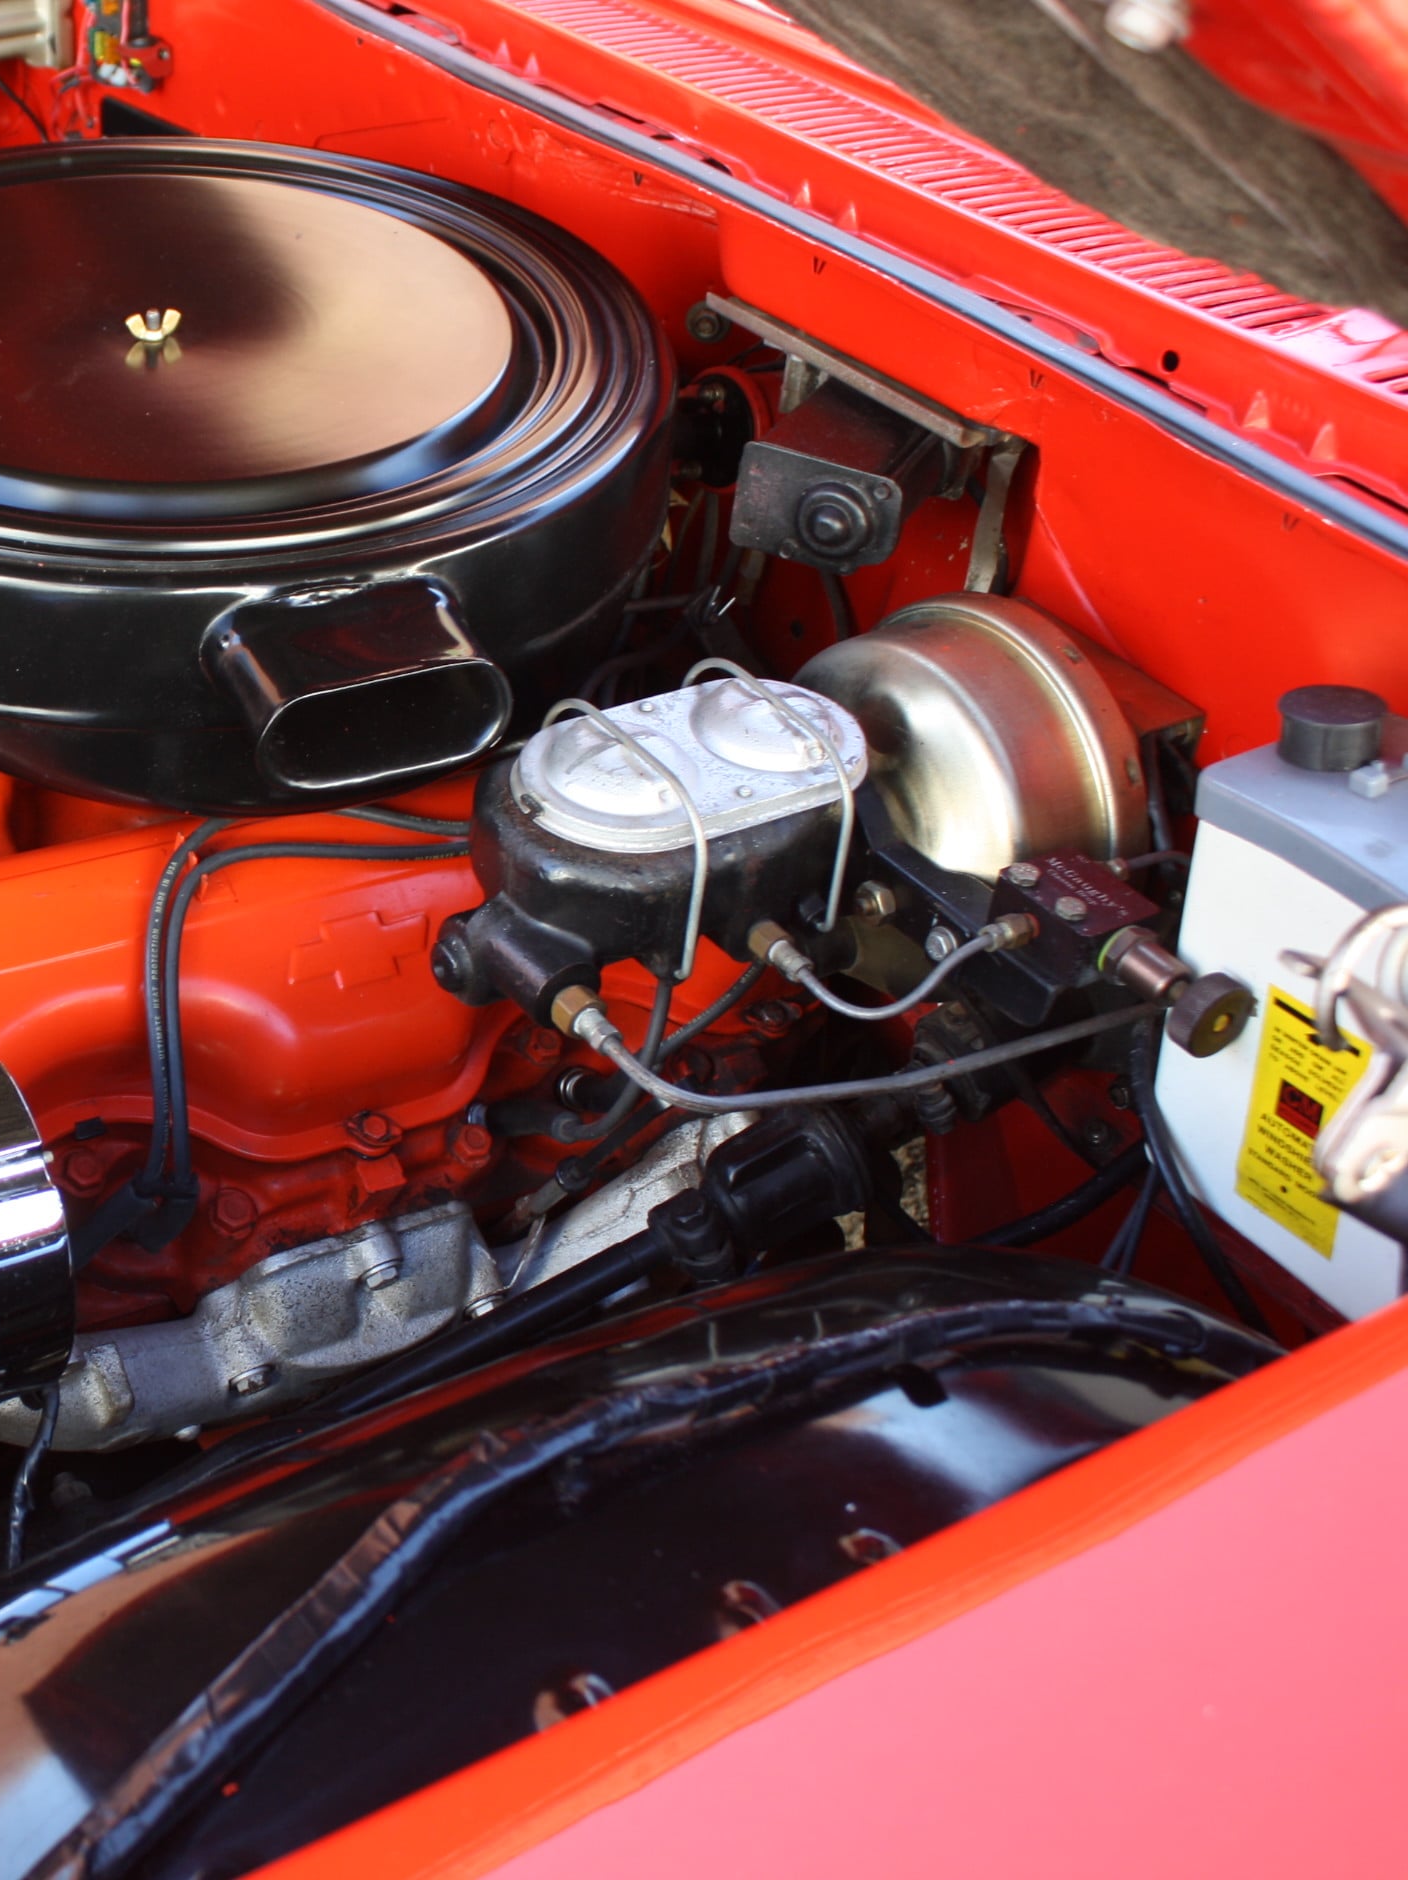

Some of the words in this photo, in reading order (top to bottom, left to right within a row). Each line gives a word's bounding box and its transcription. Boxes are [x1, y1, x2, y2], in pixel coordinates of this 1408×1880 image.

[154, 891, 166, 914] MADE
[161, 878, 170, 888] IN
[151, 927, 160, 981] PROTECTION
[1256, 1124, 1312, 1167] WINDSHIE
[1258, 1110, 1314, 1152] AUTOMAT
